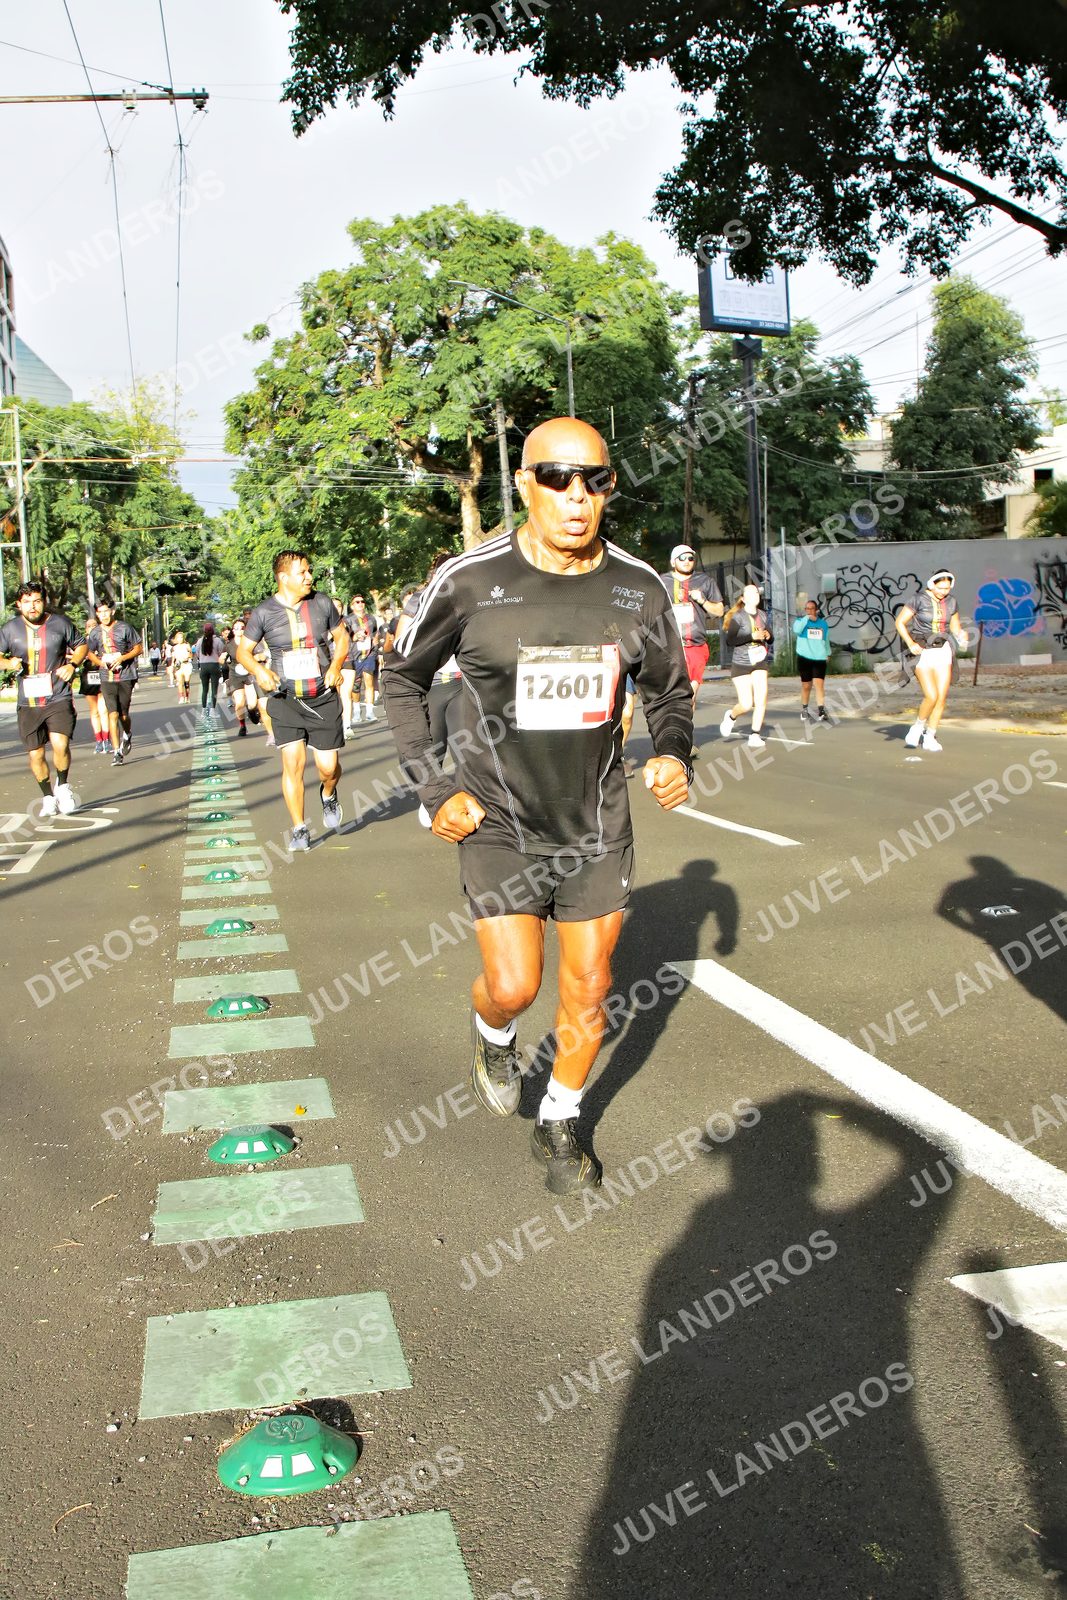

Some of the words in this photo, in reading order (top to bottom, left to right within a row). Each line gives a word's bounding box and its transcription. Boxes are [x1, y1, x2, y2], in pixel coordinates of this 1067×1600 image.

[837, 561, 878, 578] TOY
[610, 598, 644, 612] ALEX
[522, 673, 604, 700] 12601
